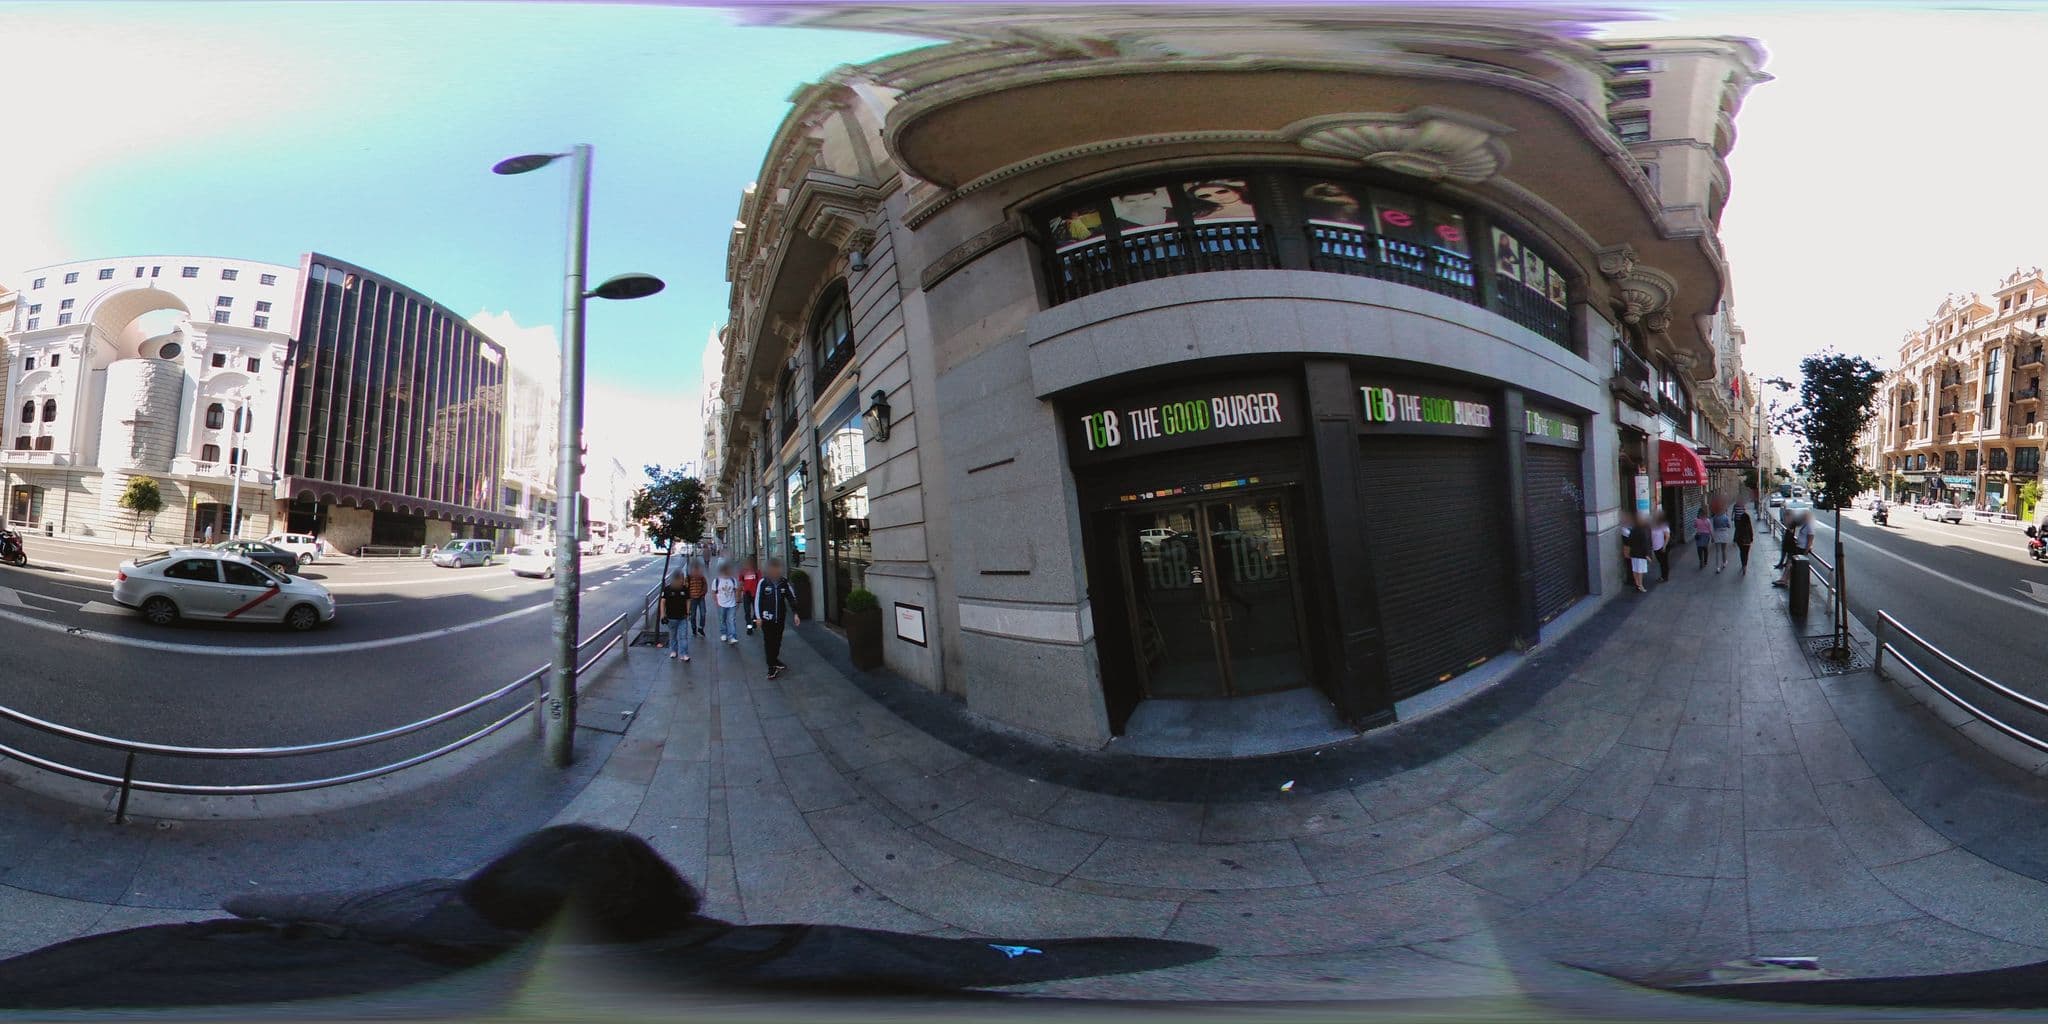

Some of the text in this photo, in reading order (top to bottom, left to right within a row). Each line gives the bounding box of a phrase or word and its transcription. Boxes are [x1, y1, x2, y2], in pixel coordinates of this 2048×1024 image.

[1081, 393, 1282, 451] TGB THE GOOD BURGER
[1360, 386, 1491, 428] TGB THE GOOD BURGER
